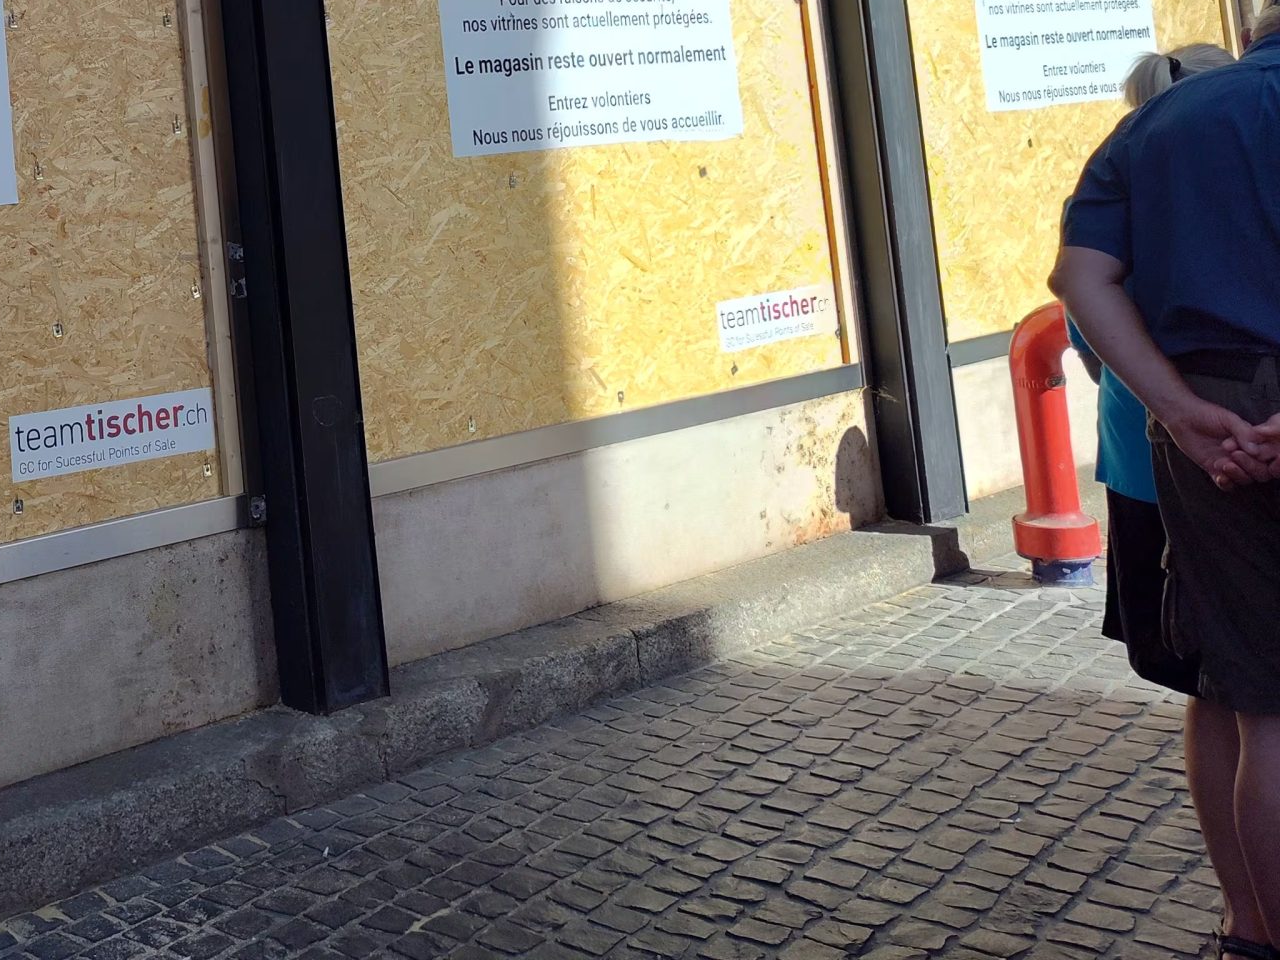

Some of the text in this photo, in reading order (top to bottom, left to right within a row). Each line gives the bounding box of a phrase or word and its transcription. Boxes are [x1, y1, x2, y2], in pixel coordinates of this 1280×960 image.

[462, 9, 713, 32] nos vitrines sont actuellement protégées.
[988, 4, 1004, 16] nos
[1006, 1, 1035, 14] vitrines
[1036, 1, 1054, 13] sont
[985, 25, 1151, 50] Le magasin reste ouvert normalement
[454, 44, 727, 77] Le magasin reste ouvert normalement
[1042, 61, 1106, 77] Entrez volontiers
[547, 89, 652, 112] Entrez volontiers
[998, 90, 1021, 103] Nous
[1022, 89, 1042, 101] nous
[1043, 83, 1088, 101] réjouissons
[1088, 82, 1099, 95] de
[1100, 82, 1118, 94] vous
[472, 110, 725, 146] Nous nous réjouissons de vous accueillir.
[15, 403, 207, 452] teamtischer.ch
[19, 438, 176, 475] GC for Sucessful Points of Sale
